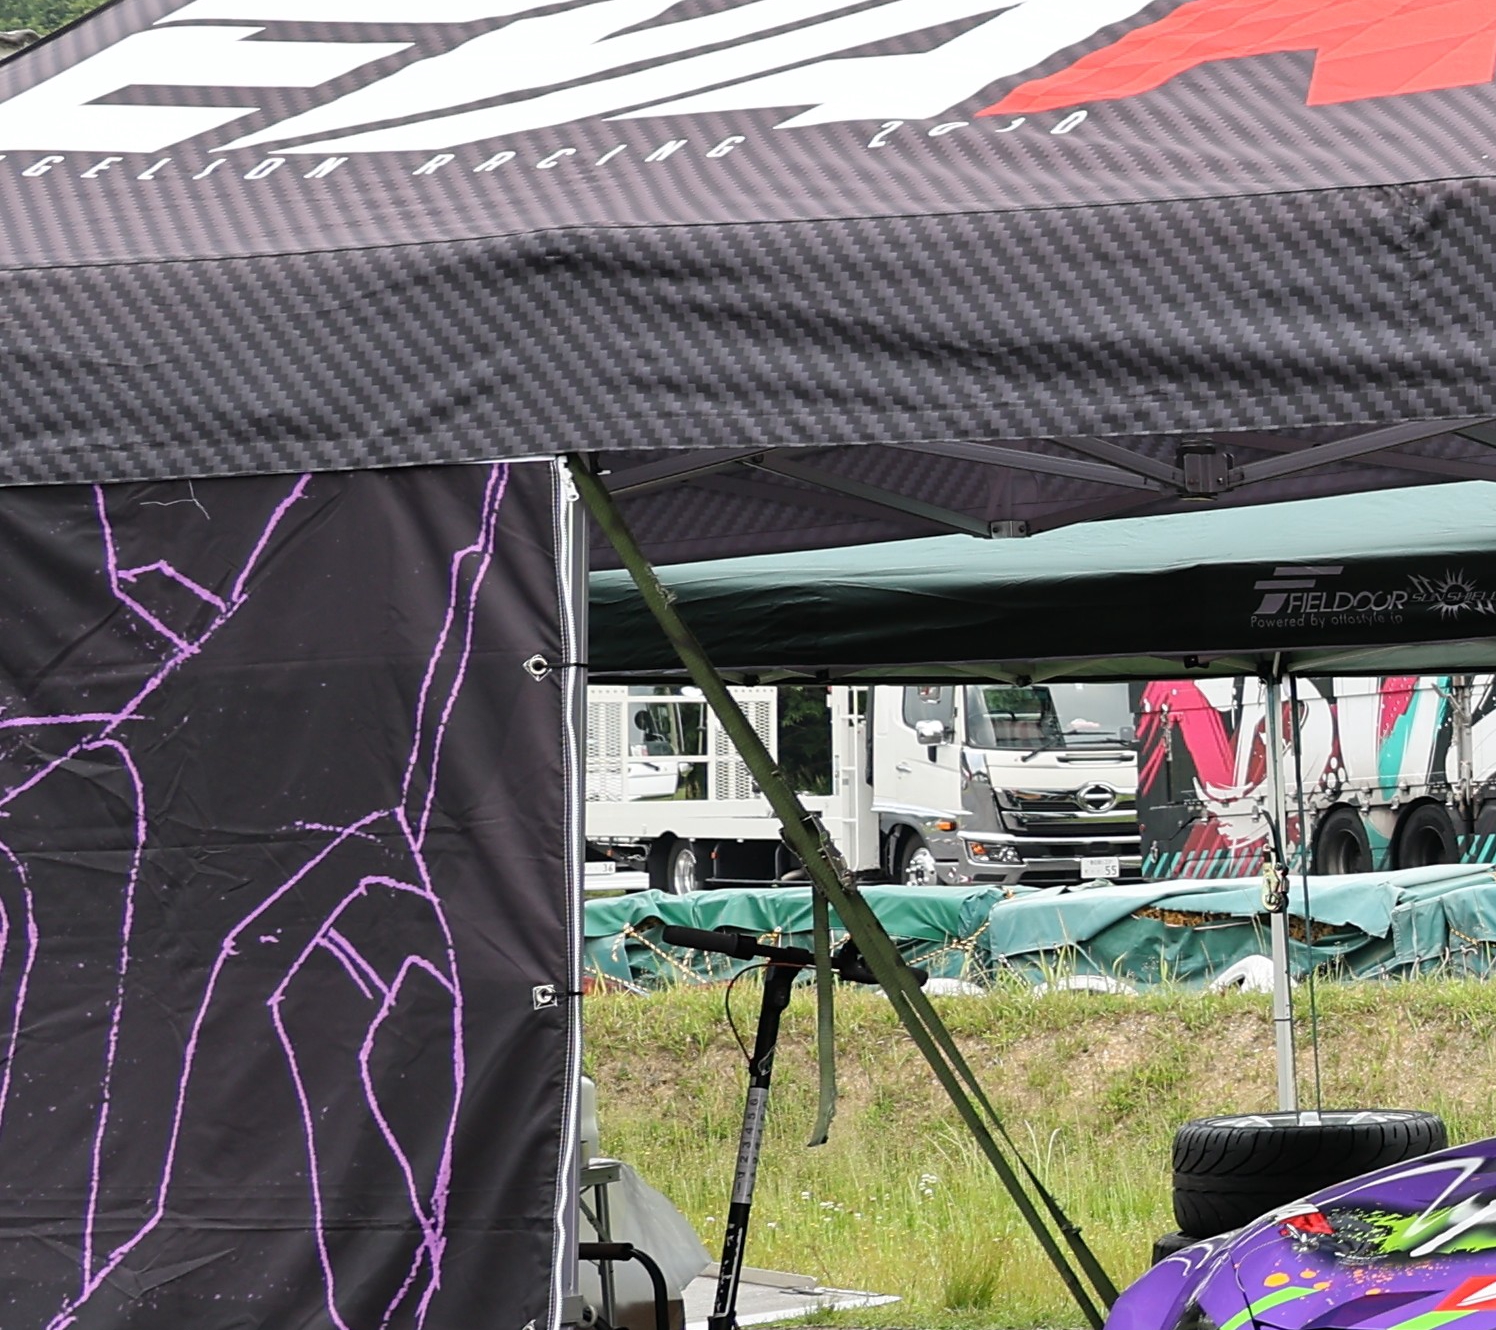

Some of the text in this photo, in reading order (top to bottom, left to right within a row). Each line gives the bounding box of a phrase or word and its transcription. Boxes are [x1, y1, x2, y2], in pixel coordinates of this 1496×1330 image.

[413, 134, 748, 176] RACING
[1250, 613, 1326, 629] Powered by
